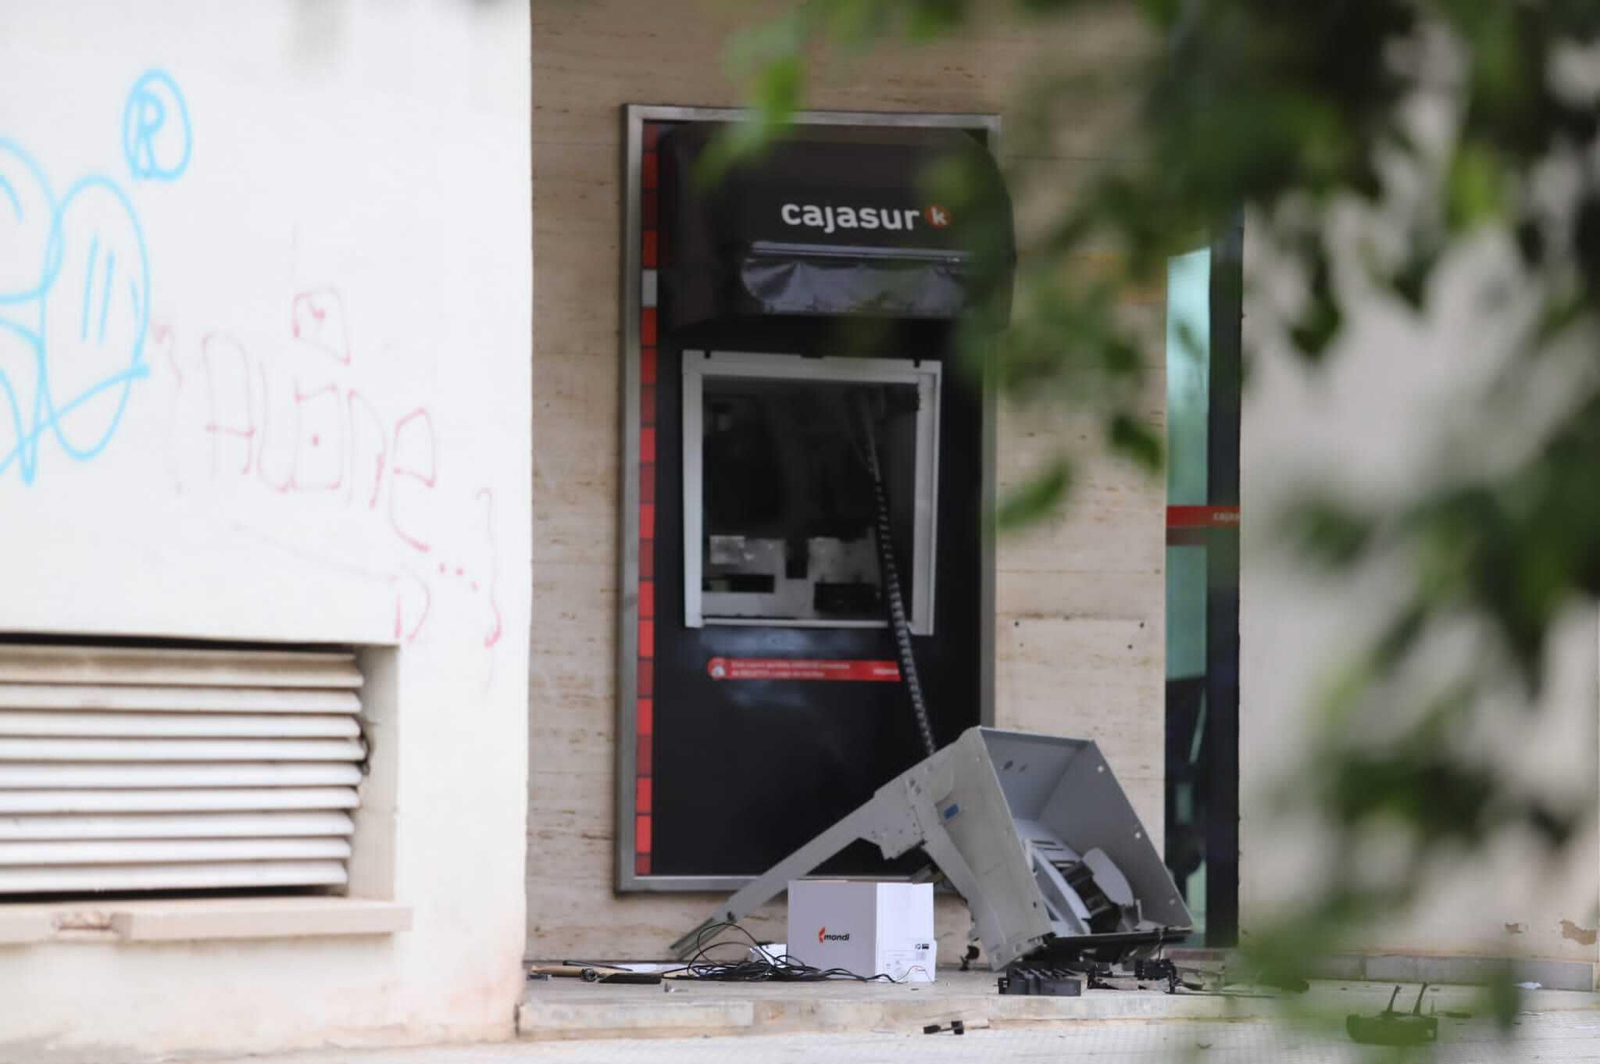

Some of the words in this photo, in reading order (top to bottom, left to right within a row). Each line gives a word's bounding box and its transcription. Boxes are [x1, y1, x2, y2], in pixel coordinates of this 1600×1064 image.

[781, 203, 919, 233] cajasur
[931, 206, 947, 226] k
[824, 933, 850, 941] mondi
